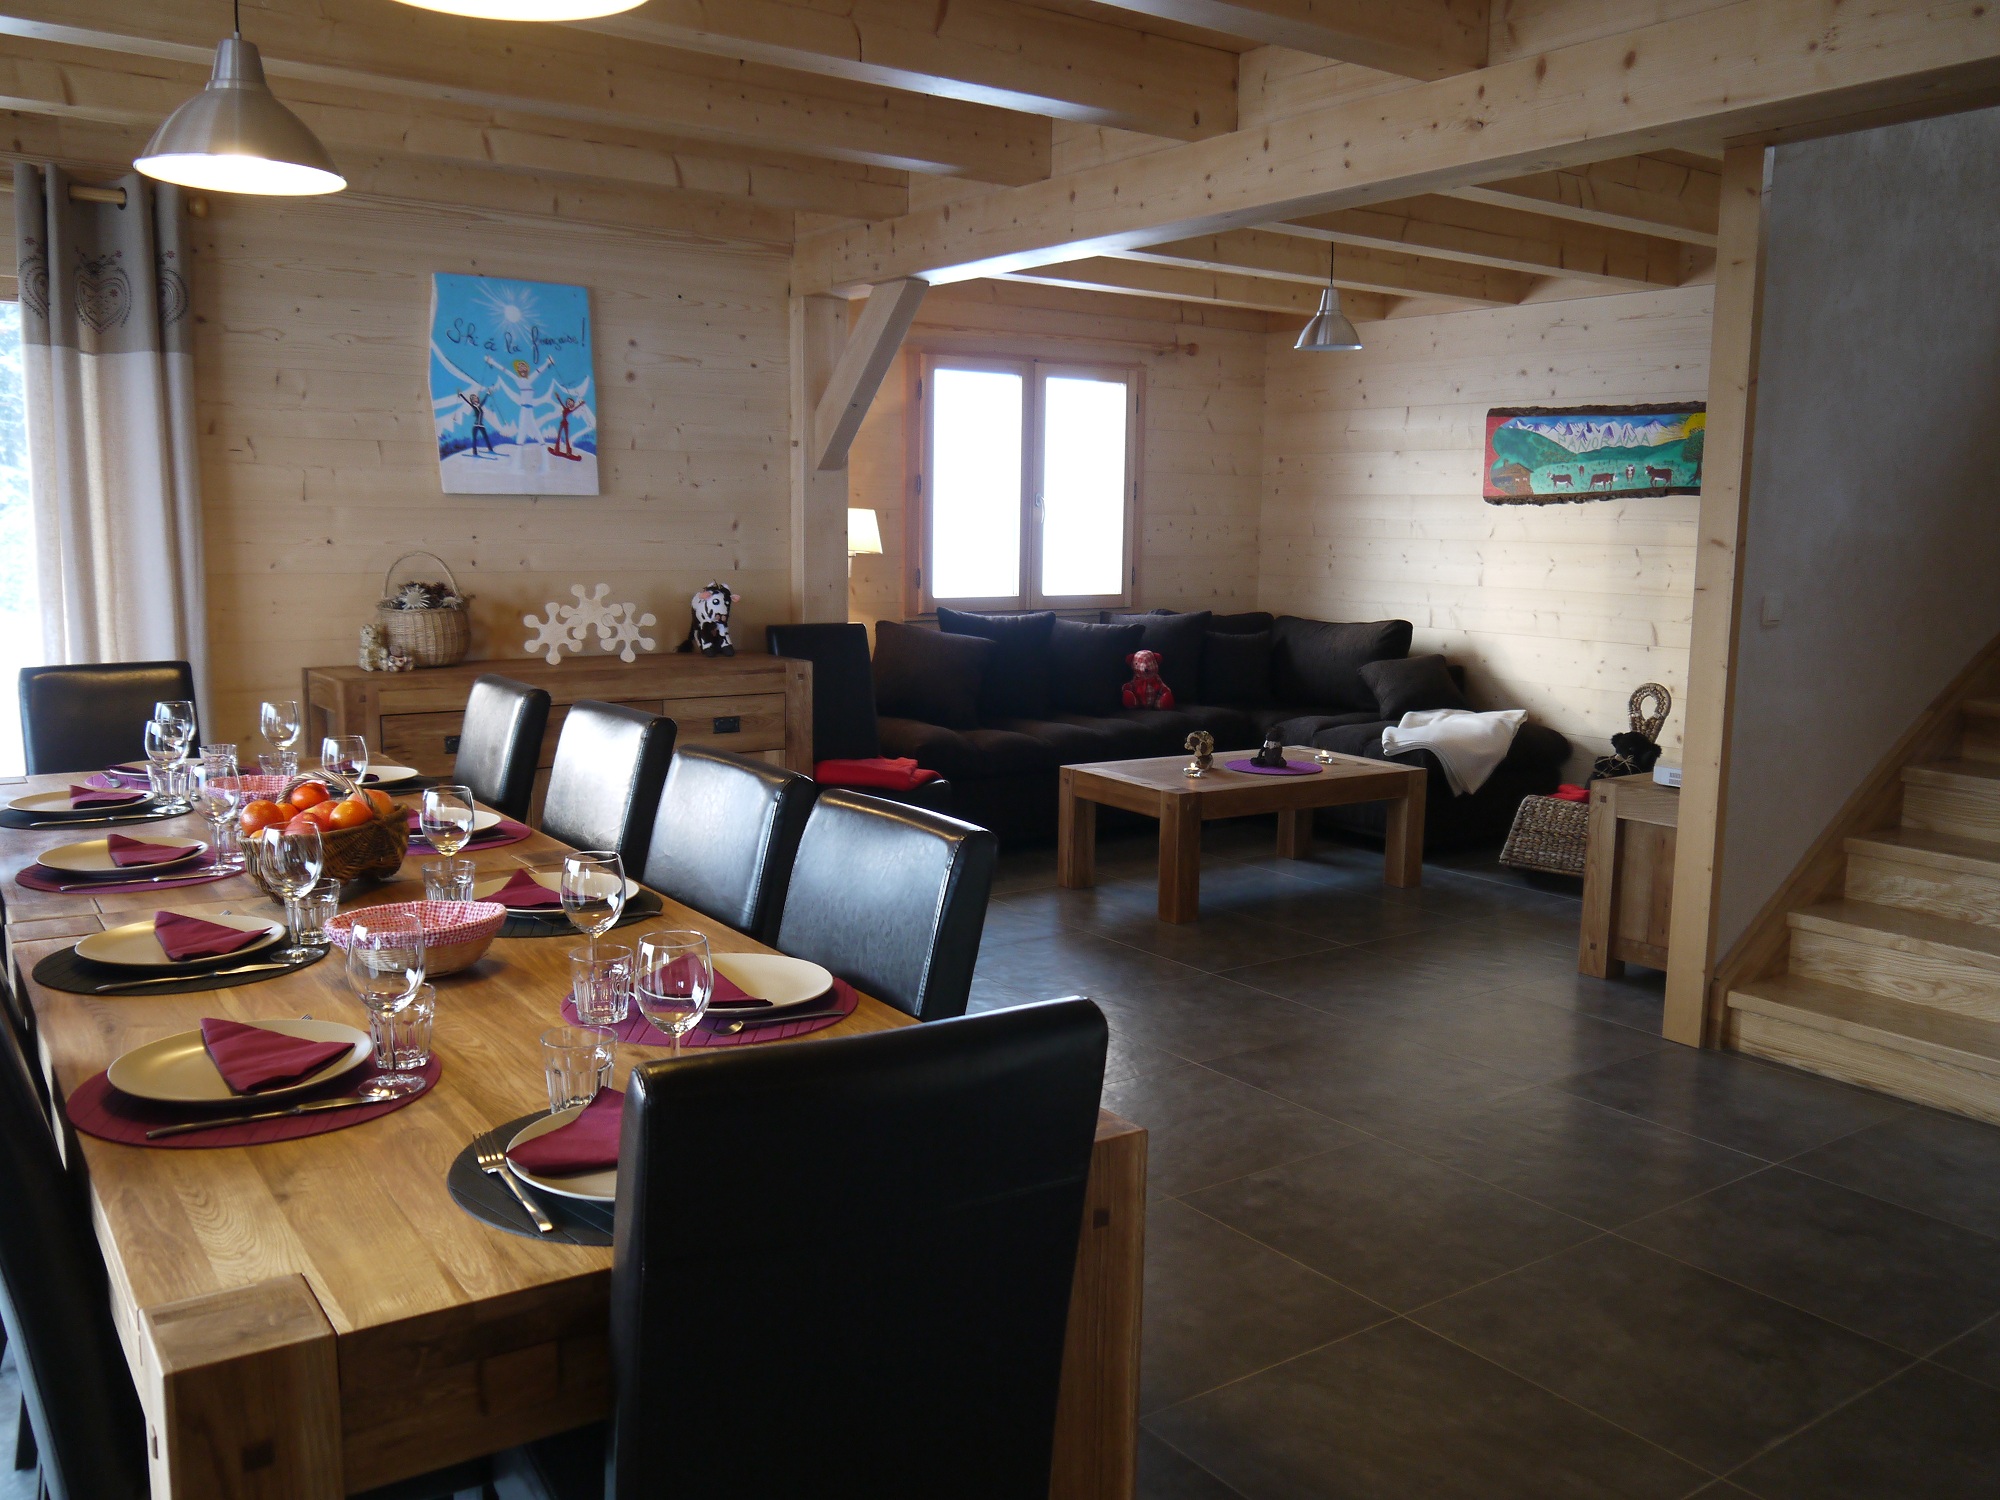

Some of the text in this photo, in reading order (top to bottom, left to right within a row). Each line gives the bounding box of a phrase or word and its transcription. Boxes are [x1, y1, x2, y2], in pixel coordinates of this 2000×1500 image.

[446, 317, 479, 346] Ski
[504, 331, 522, 354] la
[1557, 431, 1650, 452] PANORAMA
